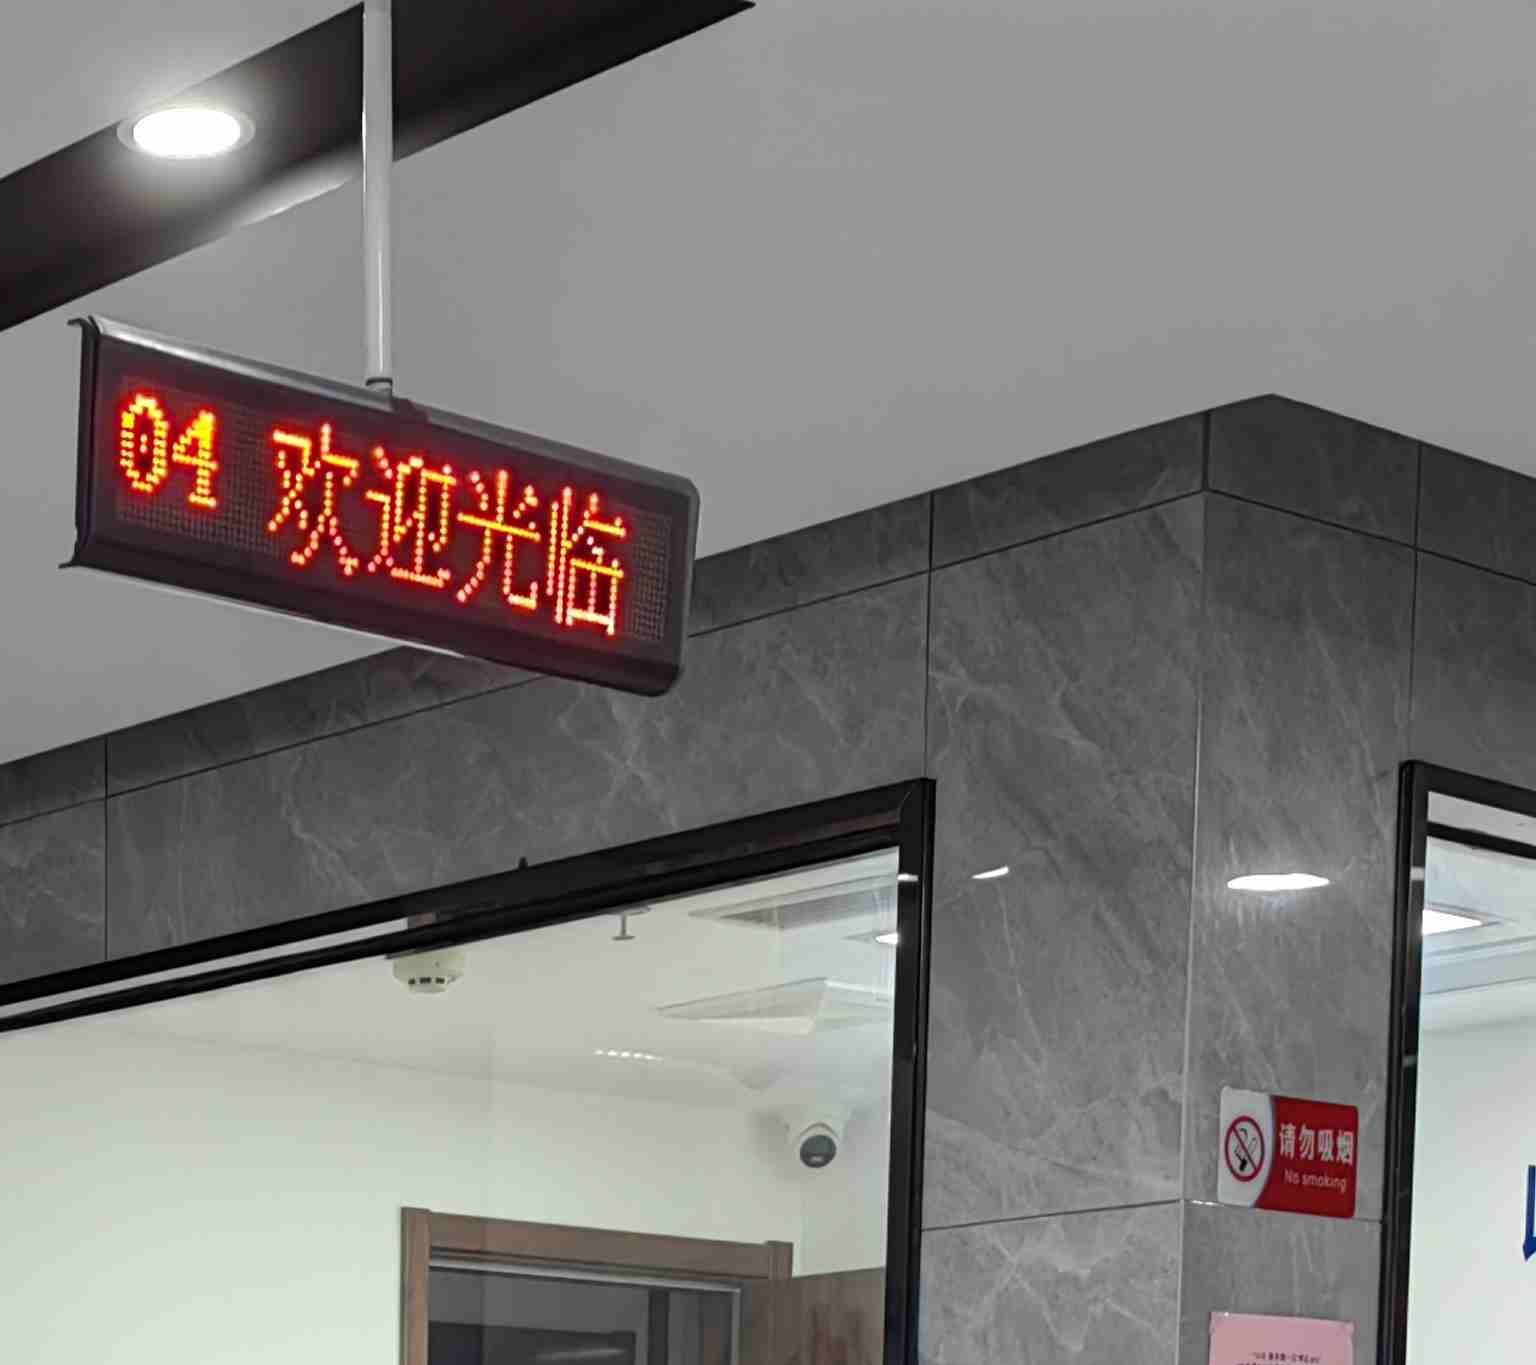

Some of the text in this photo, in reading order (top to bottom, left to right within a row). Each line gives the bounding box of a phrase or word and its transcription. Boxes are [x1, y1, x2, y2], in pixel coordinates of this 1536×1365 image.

[120, 393, 626, 636] 04 欢迎光临
[1279, 1122, 1353, 1167] 请勿吸烟
[1284, 1168, 1346, 1194] No smoking
